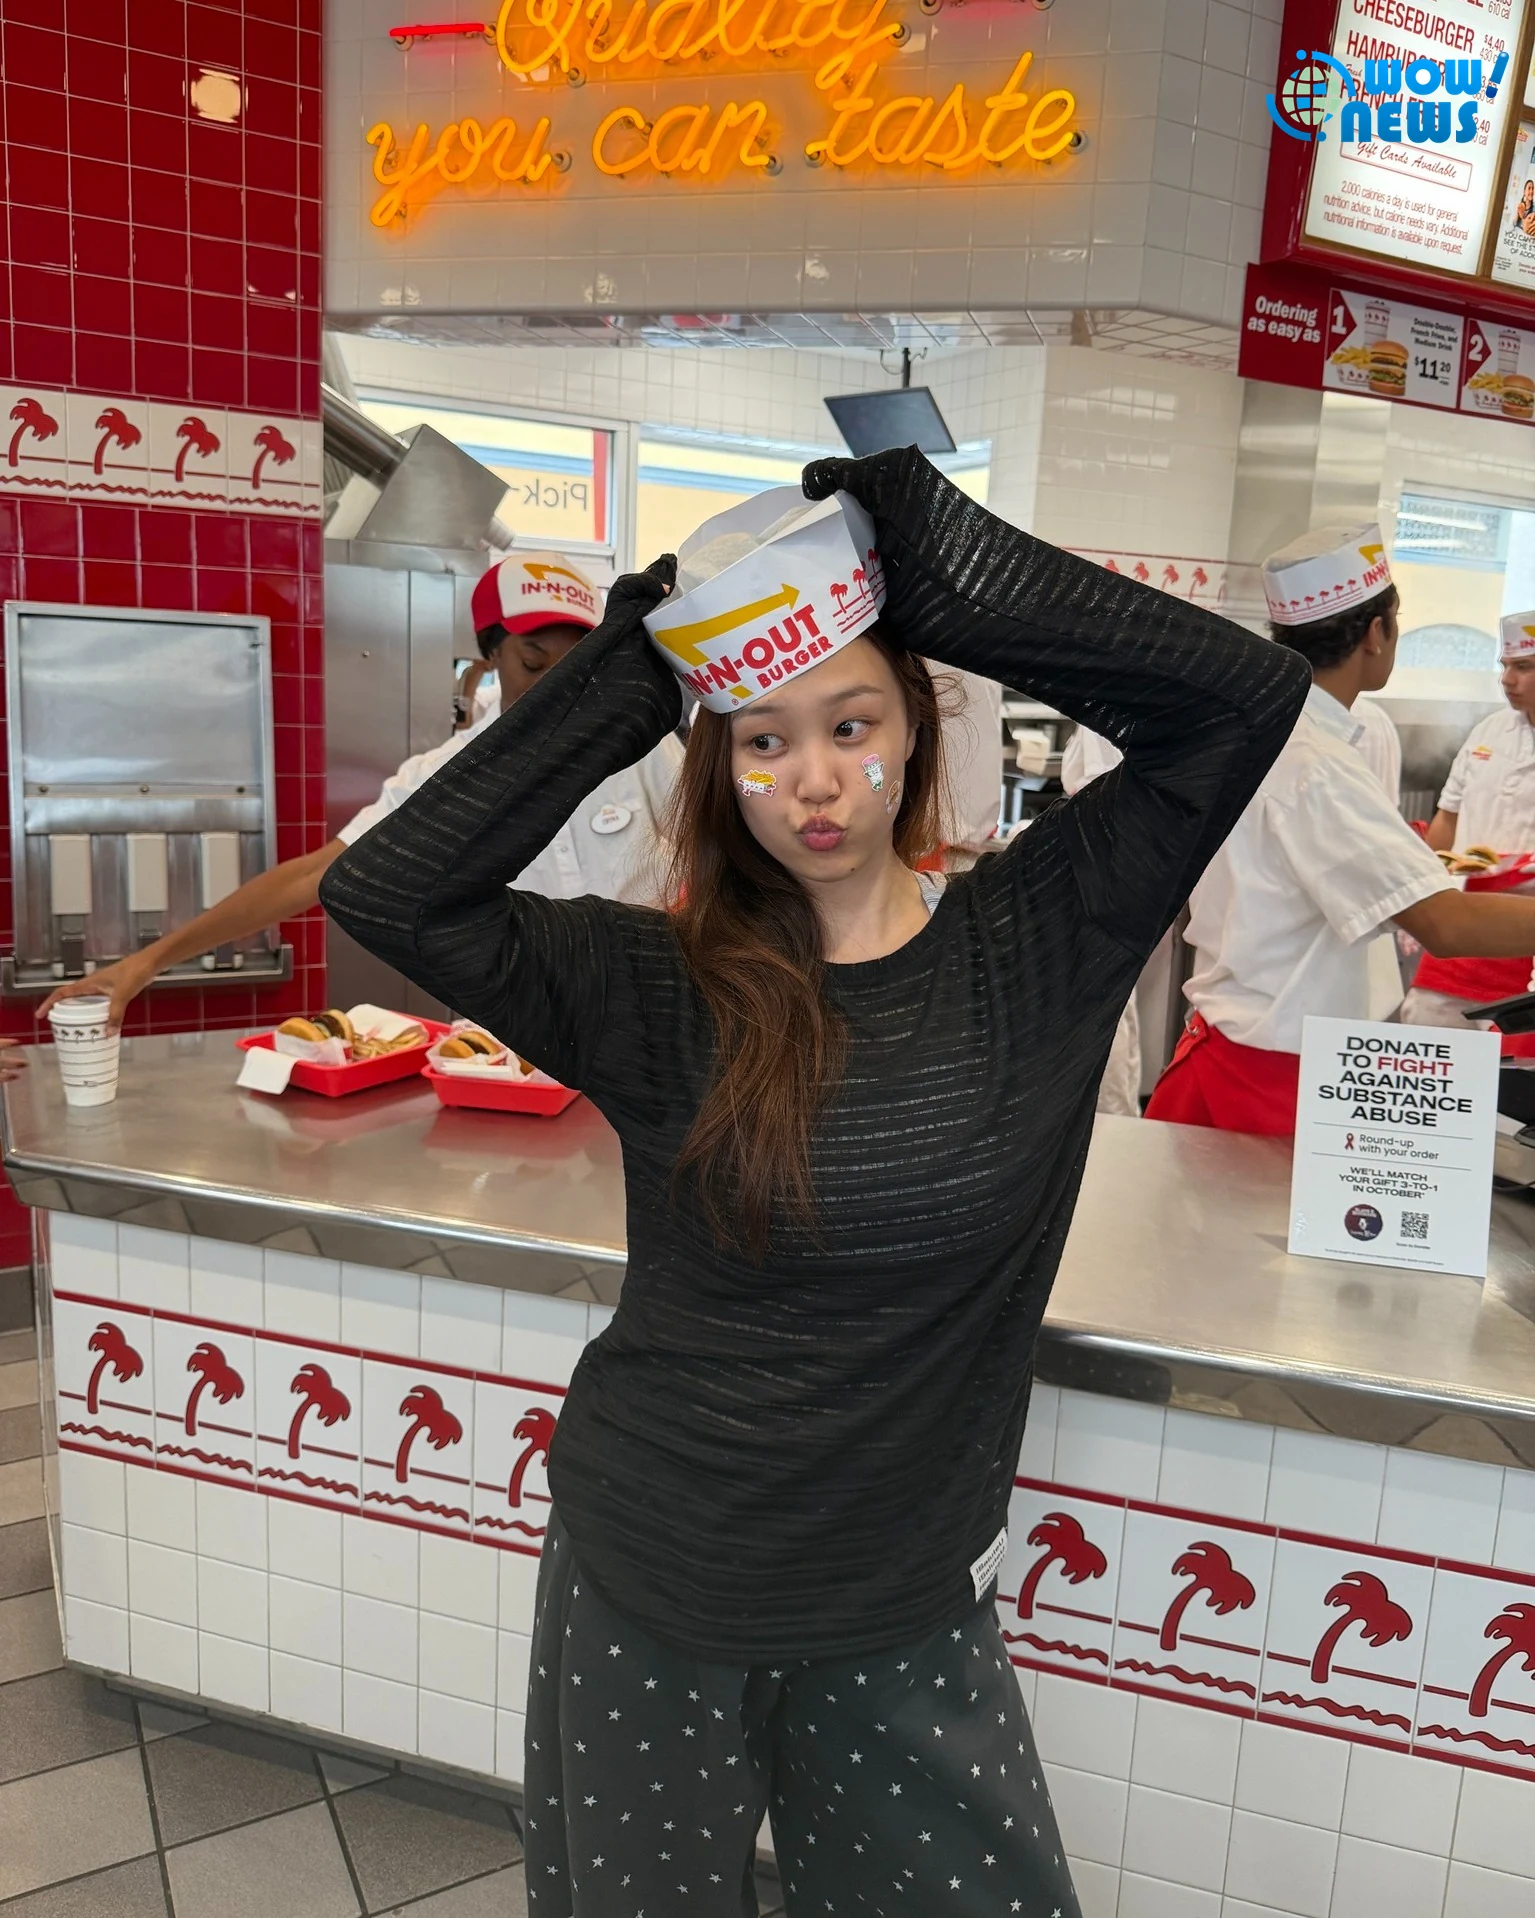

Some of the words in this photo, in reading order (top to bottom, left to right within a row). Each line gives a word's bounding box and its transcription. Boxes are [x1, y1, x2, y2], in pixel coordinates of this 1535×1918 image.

[1353, 0, 1475, 53] CHEESEBURGER
[366, 117, 556, 228] you
[593, 99, 769, 175] can
[806, 52, 1076, 169] taste
[1357, 141, 1377, 159] Gift
[1379, 145, 1409, 165] Cards
[1411, 155, 1457, 178] Available
[1361, 187, 1386, 203] calories
[1436, 208, 1459, 221] general
[1255, 294, 1318, 328] Ordering
[1331, 305, 1347, 335] 1
[1247, 316, 1266, 333] as
[1267, 321, 1303, 343] easy
[1302, 328, 1321, 343] as
[1468, 334, 1484, 361] 2
[521, 582, 594, 607] IN-N-OUT
[756, 635, 834, 689] BURGER
[1346, 1036, 1450, 1059] DONATE
[1337, 1052, 1371, 1069] TO
[1377, 1056, 1454, 1076] FIGHT
[1339, 1070, 1453, 1093] AGAINST
[1318, 1085, 1473, 1113] SUBSTANCE
[1350, 1106, 1437, 1127] ABUSE
[1359, 1134, 1414, 1149] Round-up
[1359, 1144, 1381, 1153] with
[1384, 1147, 1408, 1157] your
[1410, 1151, 1439, 1160] order
[1339, 1174, 1370, 1184] YOUR
[1372, 1178, 1398, 1187] GIFT
[1400, 1181, 1438, 1191] 3-TO-1
[1387, 1171, 1428, 1181] MATCH
